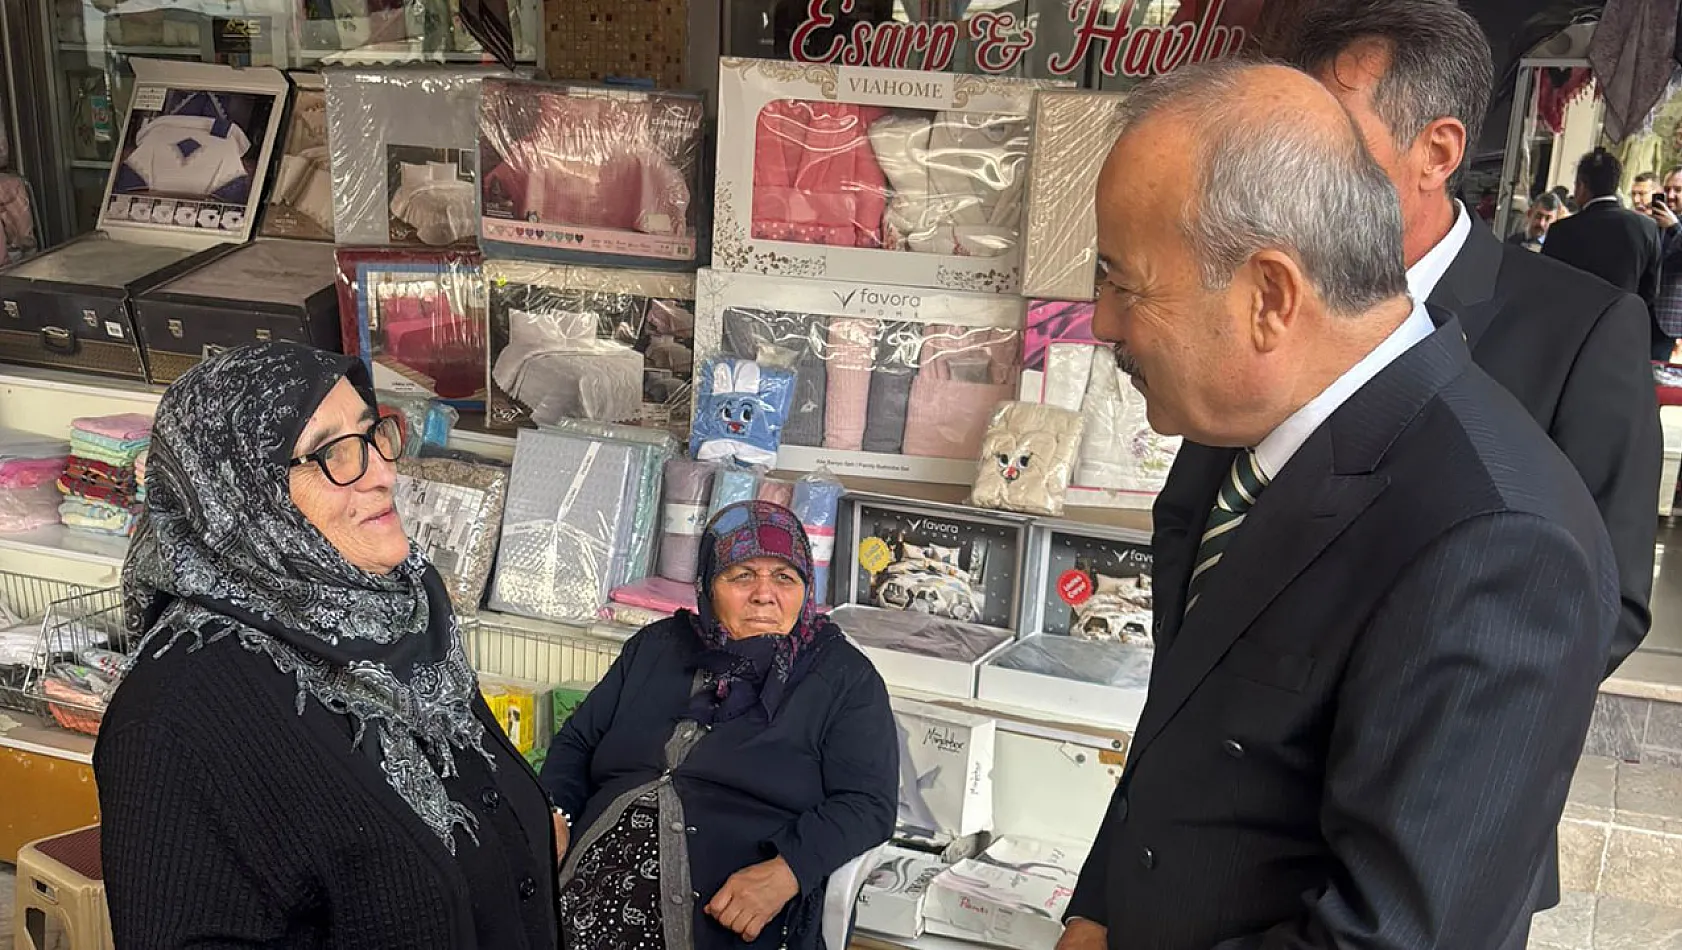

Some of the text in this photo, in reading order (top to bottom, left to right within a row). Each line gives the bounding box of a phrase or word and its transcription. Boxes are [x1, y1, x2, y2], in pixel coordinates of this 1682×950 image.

[970, 12, 1034, 73] &
[849, 77, 943, 98] VIAHOME
[860, 288, 921, 307] favora
[922, 519, 959, 533] favora
